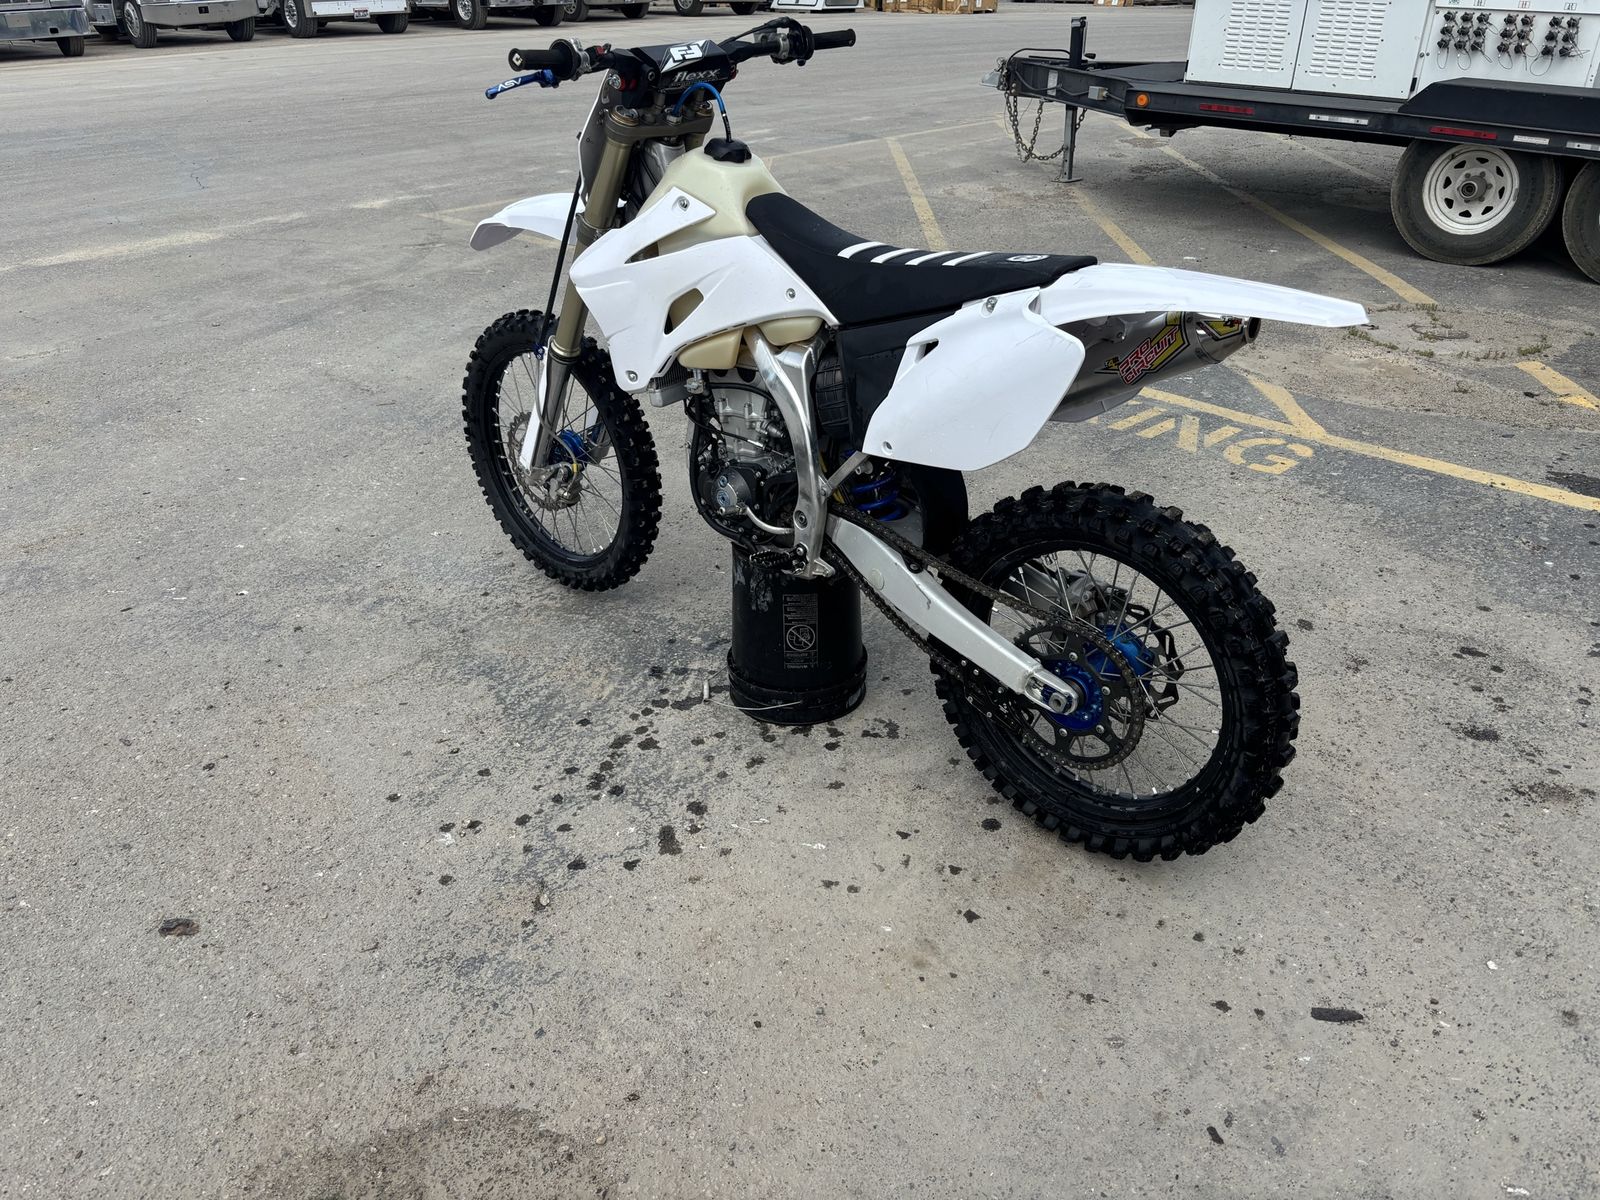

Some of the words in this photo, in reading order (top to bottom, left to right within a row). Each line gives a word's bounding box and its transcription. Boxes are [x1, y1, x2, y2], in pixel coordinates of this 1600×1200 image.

[497, 78, 522, 92] ASV
[673, 68, 721, 82] flexx
[1118, 337, 1152, 376] PRO
[1122, 325, 1179, 384] CIRCUIT
[1088, 400, 1314, 475] ING
